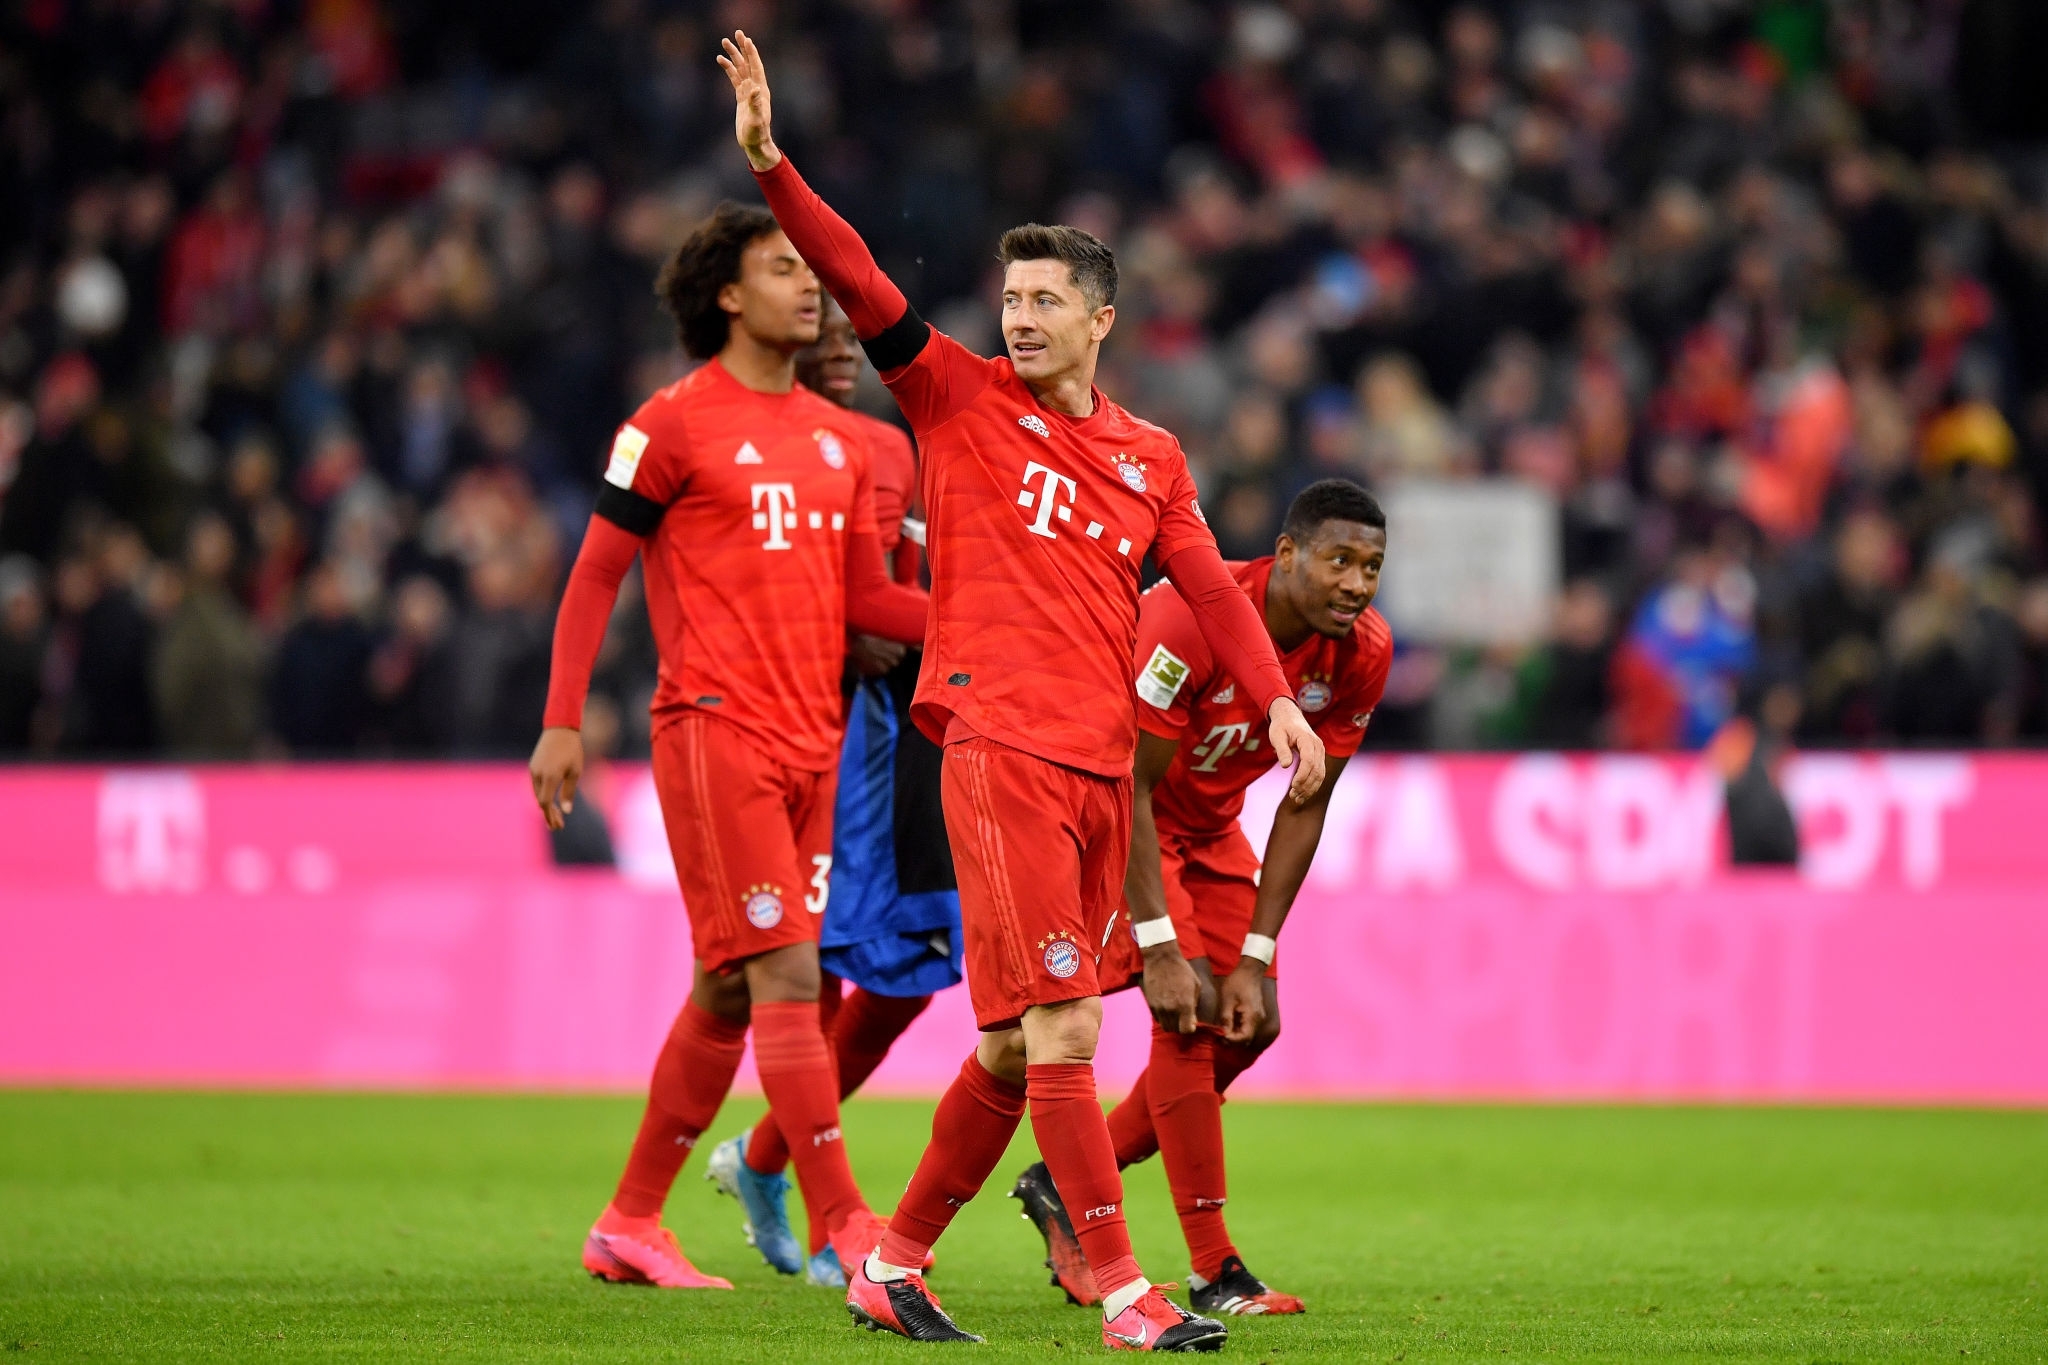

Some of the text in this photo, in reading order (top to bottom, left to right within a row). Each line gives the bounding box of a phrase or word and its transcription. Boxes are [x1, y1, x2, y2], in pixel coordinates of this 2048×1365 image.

[1018, 416, 1050, 438] adidas
[1051, 943, 1076, 956] BAYERN
[1085, 1204, 1116, 1221] FCB
